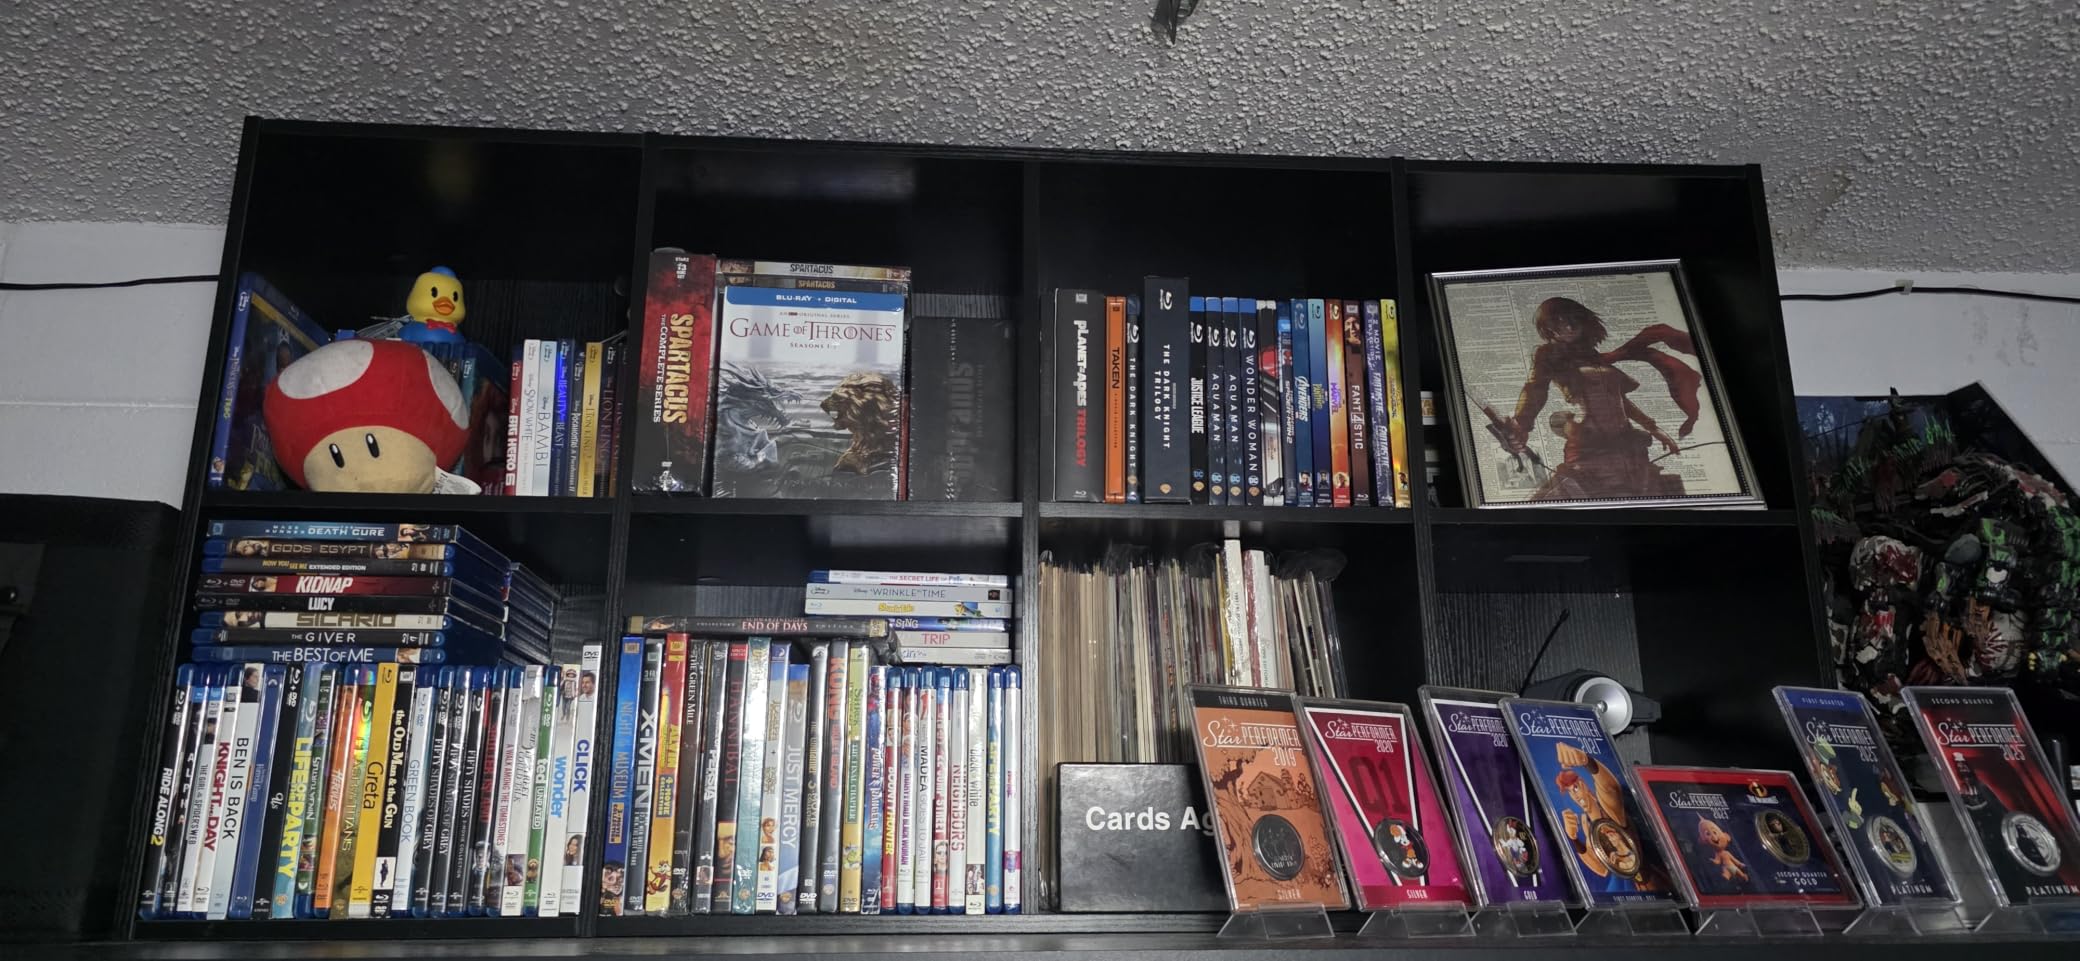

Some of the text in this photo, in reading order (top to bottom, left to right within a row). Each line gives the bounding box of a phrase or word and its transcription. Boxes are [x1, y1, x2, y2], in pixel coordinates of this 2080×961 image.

[790, 263, 833, 274] SPARTACUS
[799, 281, 835, 289] SPARTACUS
[776, 294, 857, 304] BLU-RAY DIGITAL
[730, 318, 896, 342] GAME THRONES
[653, 326, 668, 423] COMPLETE SERIES
[663, 313, 694, 424] SPARTACUS
[1112, 347, 1120, 389] TAKEN
[524, 389, 536, 415] SNOW
[557, 380, 568, 414] BEAUTY
[1073, 320, 1089, 467] PLANET APES TRILOGY
[1154, 371, 1162, 421] TRILOGY
[1191, 377, 1204, 434] JUSTICE LEAGUE
[1212, 374, 1220, 441] AQUAMAN
[1229, 374, 1238, 442] AQUAMAN
[1229, 374, 1238, 442] AQUAMAN
[1245, 355, 1258, 471] WONDER WOMAN
[1295, 375, 1309, 422] AVENGERS
[522, 417, 533, 441] WHITE
[554, 422, 565, 448] BEAST
[1352, 385, 1364, 450] FANT4STIC
[505, 416, 518, 486] BIG HERO 6
[536, 412, 550, 467] BAMBI
[271, 545, 367, 554] GODS EGYPT
[307, 527, 385, 536] DEATH CURE
[296, 576, 353, 593] KIDNAP
[308, 597, 335, 611] LUCY
[872, 589, 945, 598] WRINKLE TIME
[296, 613, 397, 627] SICARIO
[305, 633, 356, 643] GIVER
[742, 622, 763, 630] END
[783, 623, 808, 631] DAYS
[895, 619, 918, 628] SING
[922, 633, 950, 645] TRIP
[272, 648, 374, 662] THE BEST OF ME
[686, 672, 696, 726] GREEN MILE
[1218, 696, 1238, 705] THIRD
[724, 681, 743, 788] HANNIBAL
[828, 657, 845, 789] KONG ISLAND
[1203, 720, 1302, 747] Star PERFORMER
[1325, 720, 1397, 740] Star PERFORMER
[1449, 713, 1472, 733] Star
[1493, 734, 1509, 748] 2020
[1519, 712, 1602, 738] Star PERFORMER
[1806, 721, 1875, 745] Star PERFORMER
[1938, 722, 2024, 745] Star PERFORMER
[573, 739, 590, 793] CLICK
[612, 701, 633, 798] NIGHT MUSEUM
[634, 710, 655, 812] X-MEN
[666, 724, 680, 769] ALVIN
[1271, 747, 1297, 767] 2019
[1375, 740, 1394, 753] 2020
[1577, 738, 1601, 755] 2021
[222, 738, 249, 840] BEN IS BACK
[306, 756, 322, 820] NINJA TURTLES
[329, 768, 343, 812] HERCULES
[362, 761, 383, 810] Greta
[384, 710, 406, 829] the OLD the GUN
[460, 750, 476, 818] FIFTY SHADES
[503, 768, 512, 790] AMONG
[550, 756, 568, 819] wonder
[704, 750, 718, 802] PERSIA
[848, 744, 859, 820] THE FINAL CHAPTER
[868, 747, 882, 830] POWER RANGERS
[919, 745, 928, 792] MADEA
[150, 768, 173, 847] RIDE ALONG 2
[204, 742, 230, 852] KNIGHT DAY
[278, 737, 313, 878] LIFE PARTY
[400, 759, 420, 842] GREEN BOOK
[422, 738, 444, 852] FIFTY SHADES GREY
[438, 772, 456, 856] SHADES GREY
[501, 792, 510, 803] THE
[535, 759, 548, 826] ted UNRATED
[782, 745, 801, 848] JUST MERCY
[951, 764, 966, 852] NEIGHBORS
[1669, 792, 1728, 808] Star PERFORMER
[341, 804, 358, 851] TITANS
[497, 805, 508, 846] TOMBSTONES
[885, 810, 895, 856] HUNTER
[1085, 806, 1171, 832] Cards
[1277, 889, 1300, 900] SILVER
[1407, 889, 1428, 899] SILVER
[1524, 890, 1537, 900] GOLD
[1794, 878, 1818, 886] GOLD
[1890, 883, 1933, 895] PLATINUM
[2025, 885, 2080, 895] PLATINUM
